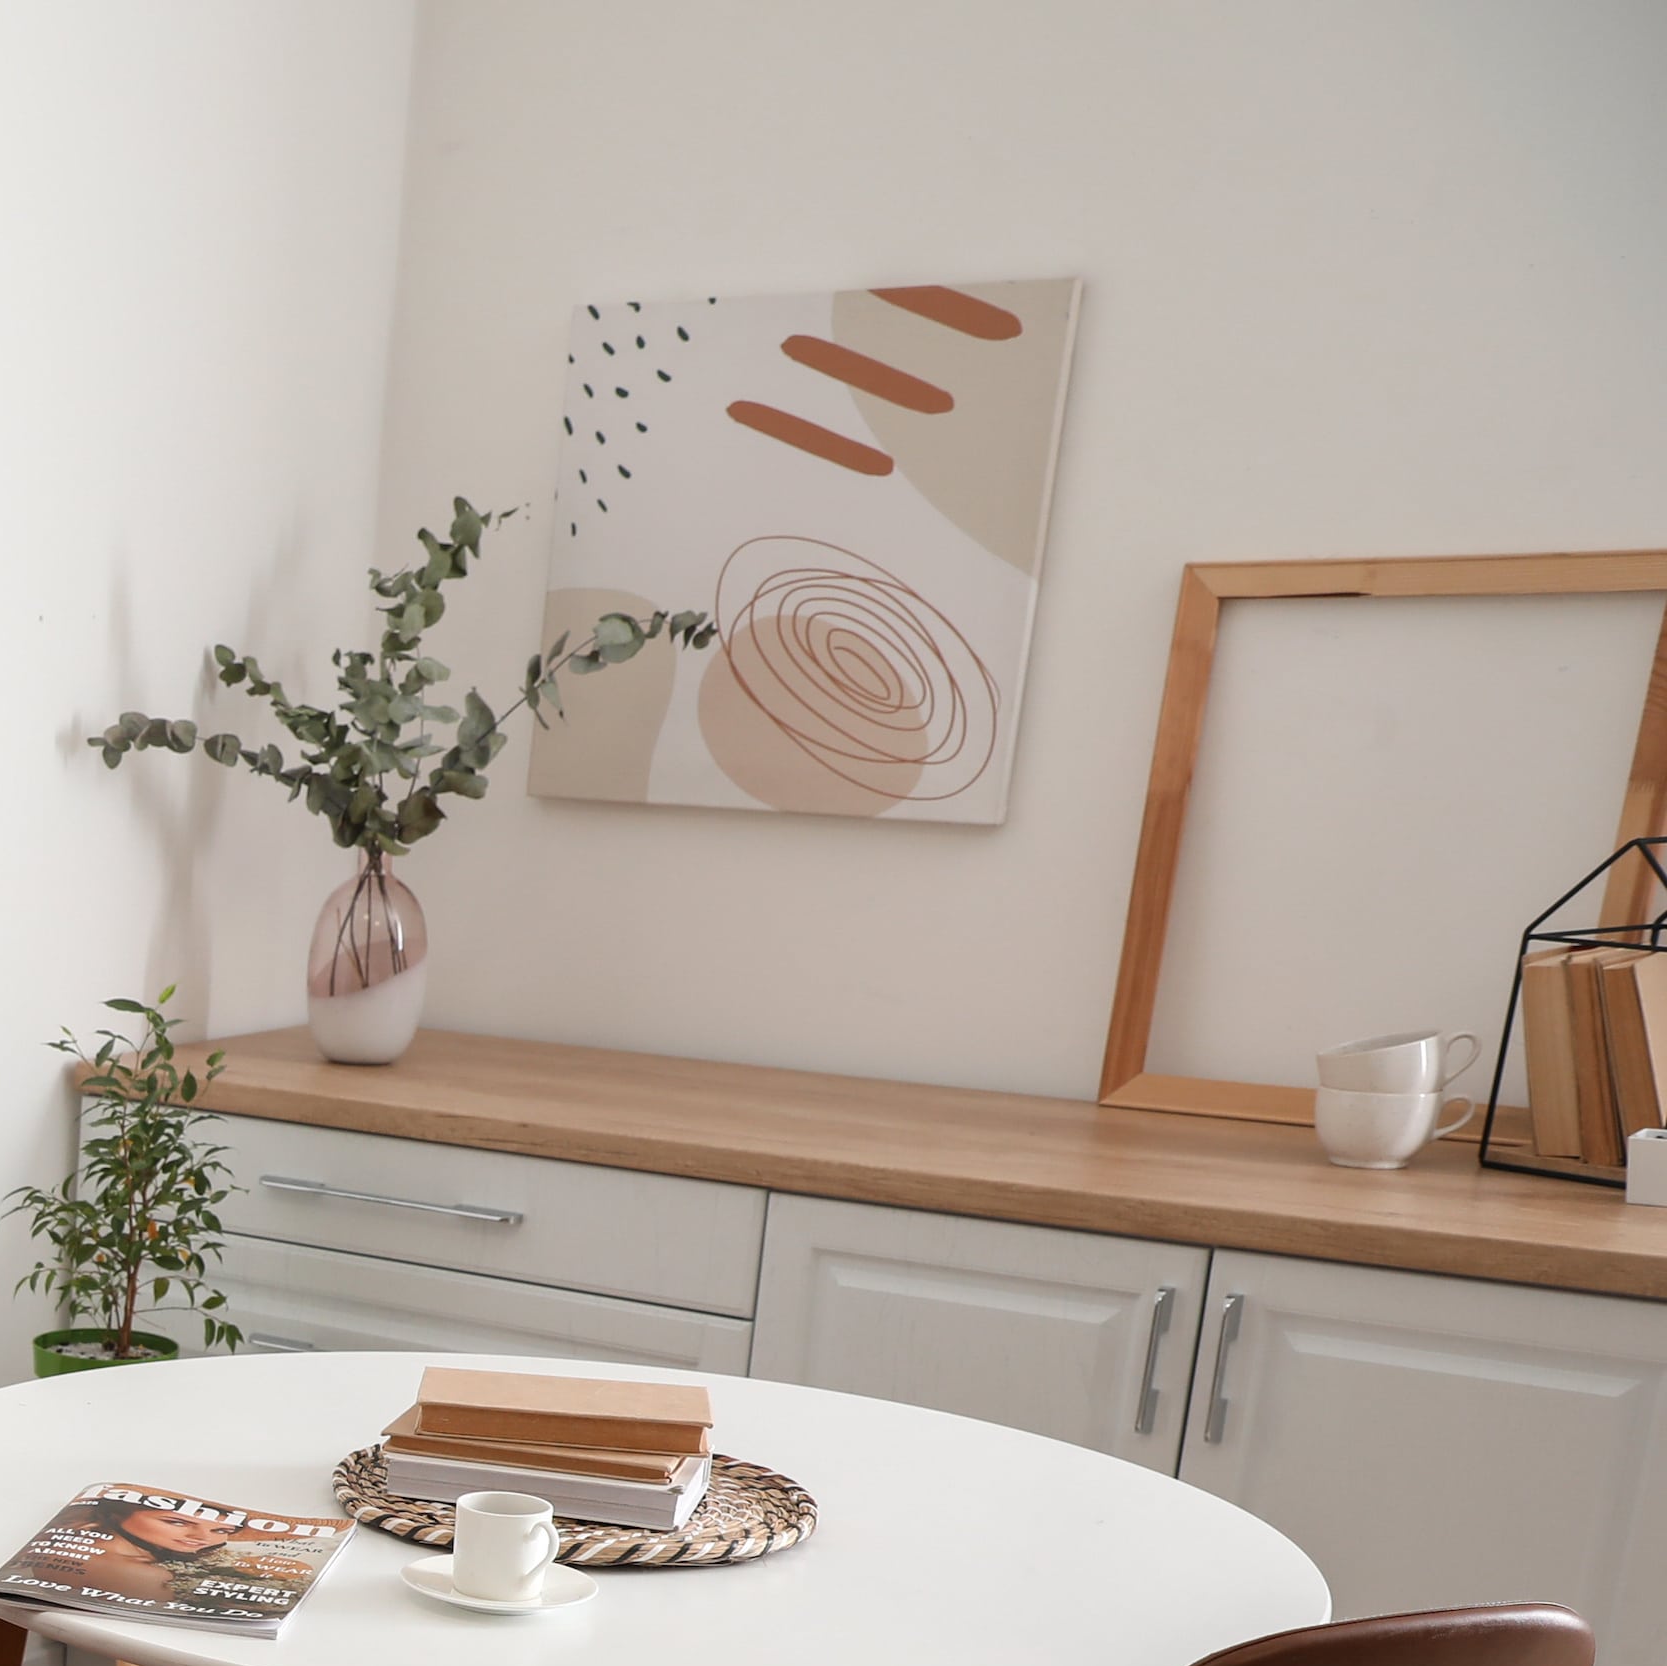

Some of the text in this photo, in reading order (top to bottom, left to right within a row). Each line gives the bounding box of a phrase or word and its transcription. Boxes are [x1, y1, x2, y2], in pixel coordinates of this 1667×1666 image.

[46, 1527, 114, 1541] ALL YOU
[51, 1534, 95, 1545] NEED
[53, 1541, 106, 1555] KNOW
[273, 1544, 324, 1554] WEAR
[53, 1558, 84, 1567] NEW
[256, 1563, 313, 1575] WEAR
[200, 1579, 297, 1598] EXPERT
[1, 1575, 263, 1618] Love What You Do
[193, 1587, 290, 1606] STYLING
